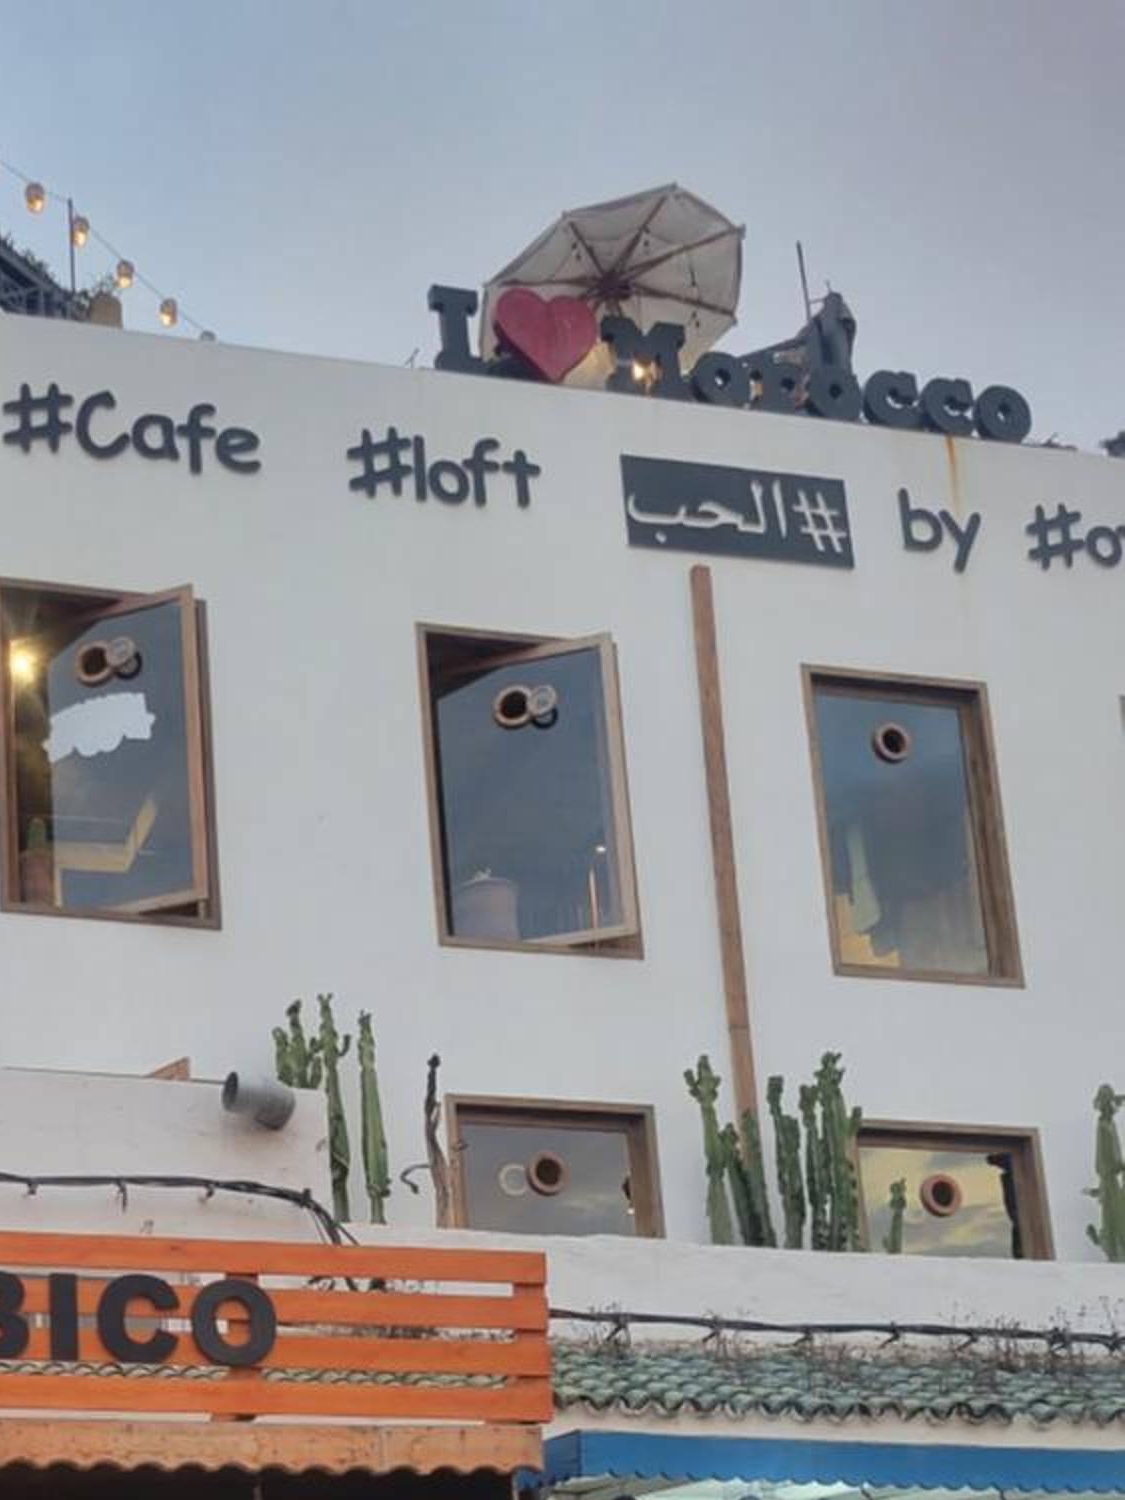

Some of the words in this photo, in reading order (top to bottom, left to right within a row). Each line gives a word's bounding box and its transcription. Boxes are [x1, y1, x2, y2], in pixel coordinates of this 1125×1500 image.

[427, 284, 478, 370] I
[2, 382, 262, 476] #Cafe
[346, 426, 542, 508] #loft
[627, 479, 847, 553] #الحب
[897, 486, 982, 574] by
[1025, 502, 1125, 570] #o
